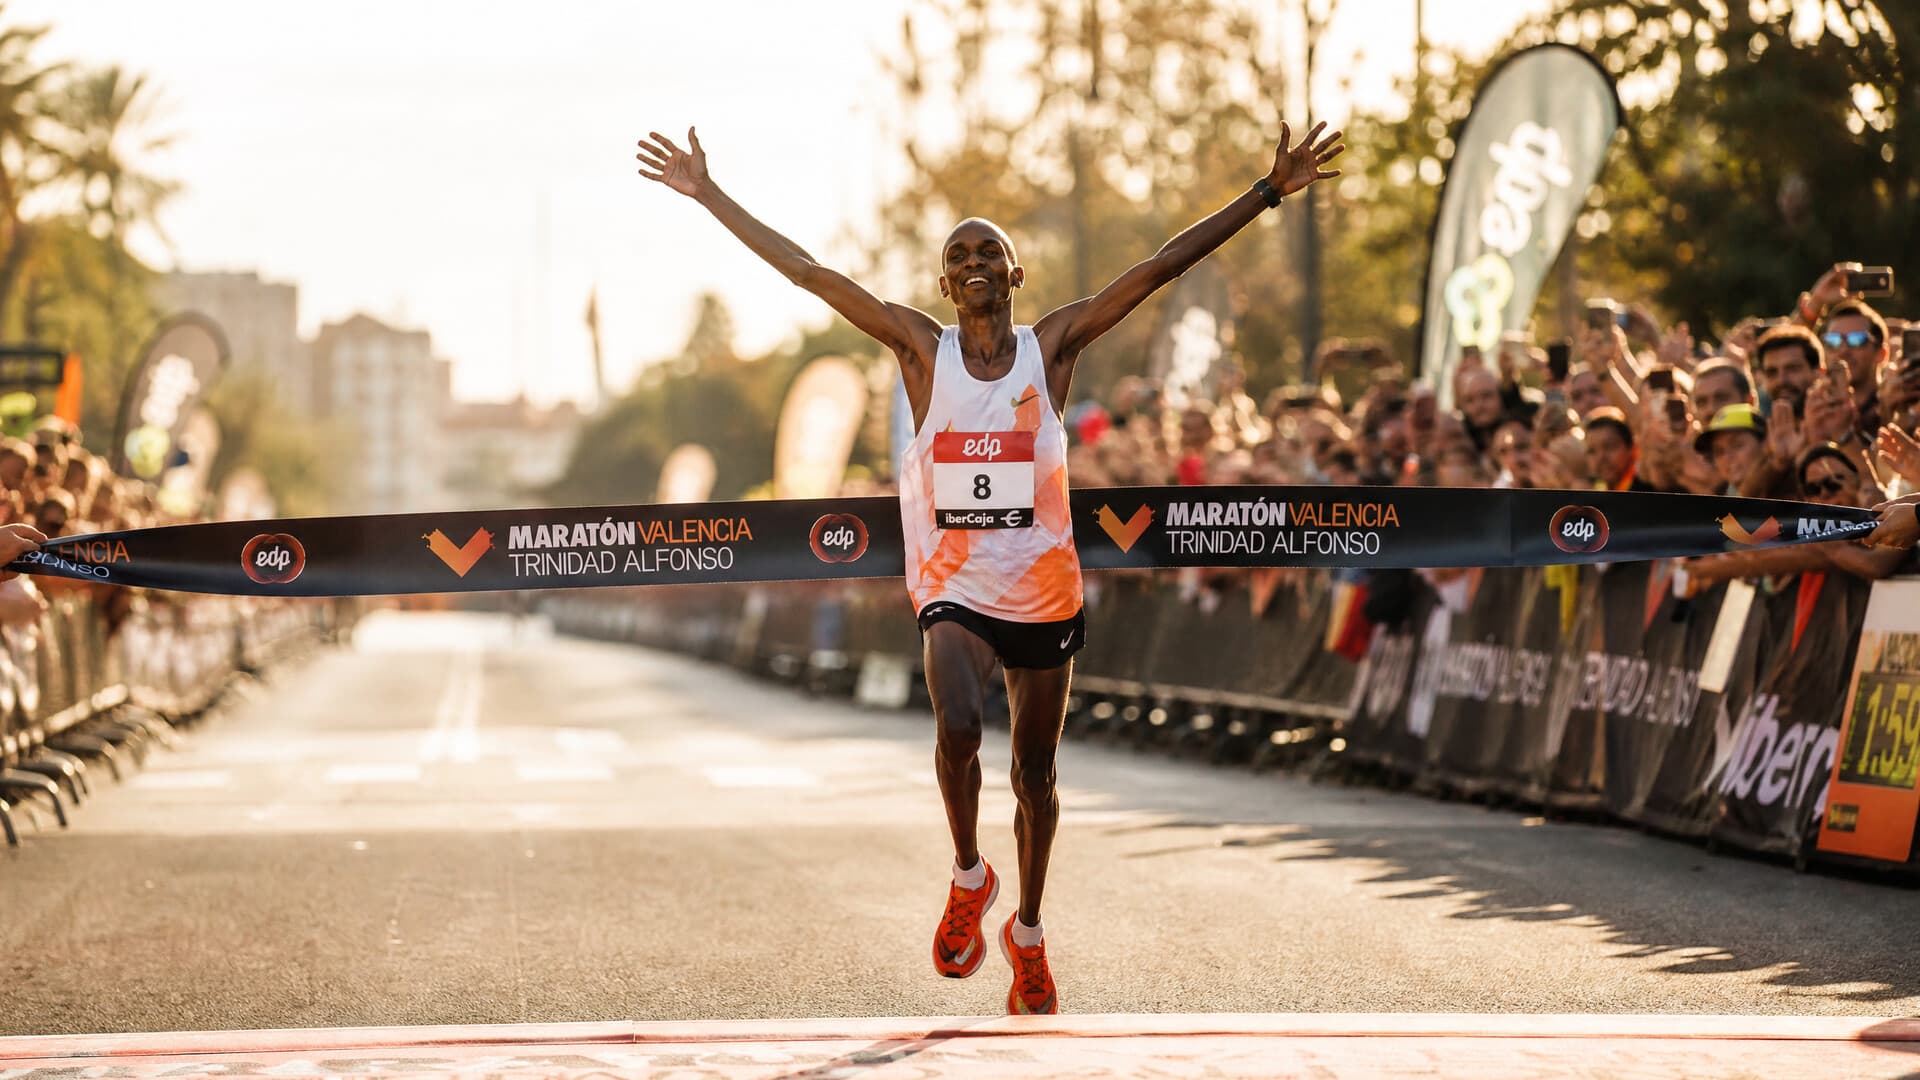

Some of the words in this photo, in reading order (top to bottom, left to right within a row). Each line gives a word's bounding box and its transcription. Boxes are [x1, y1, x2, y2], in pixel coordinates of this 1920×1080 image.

[962, 433, 1002, 461] edp
[973, 474, 992, 500] 8
[945, 513, 994, 527] iberCaja
[1166, 497, 1286, 526] MARATÓN
[1288, 502, 1400, 528] VALENCIA
[508, 517, 635, 550] MARATÓN
[637, 518, 753, 545] VALENCIA
[822, 526, 856, 551] edp
[1562, 517, 1595, 542] edp
[1166, 531, 1265, 554] TRINIDAD
[1271, 531, 1380, 555] ALFONSO
[256, 545, 291, 571] edp
[510, 550, 616, 577] TRINIDAD
[623, 546, 734, 574] ALFONSO
